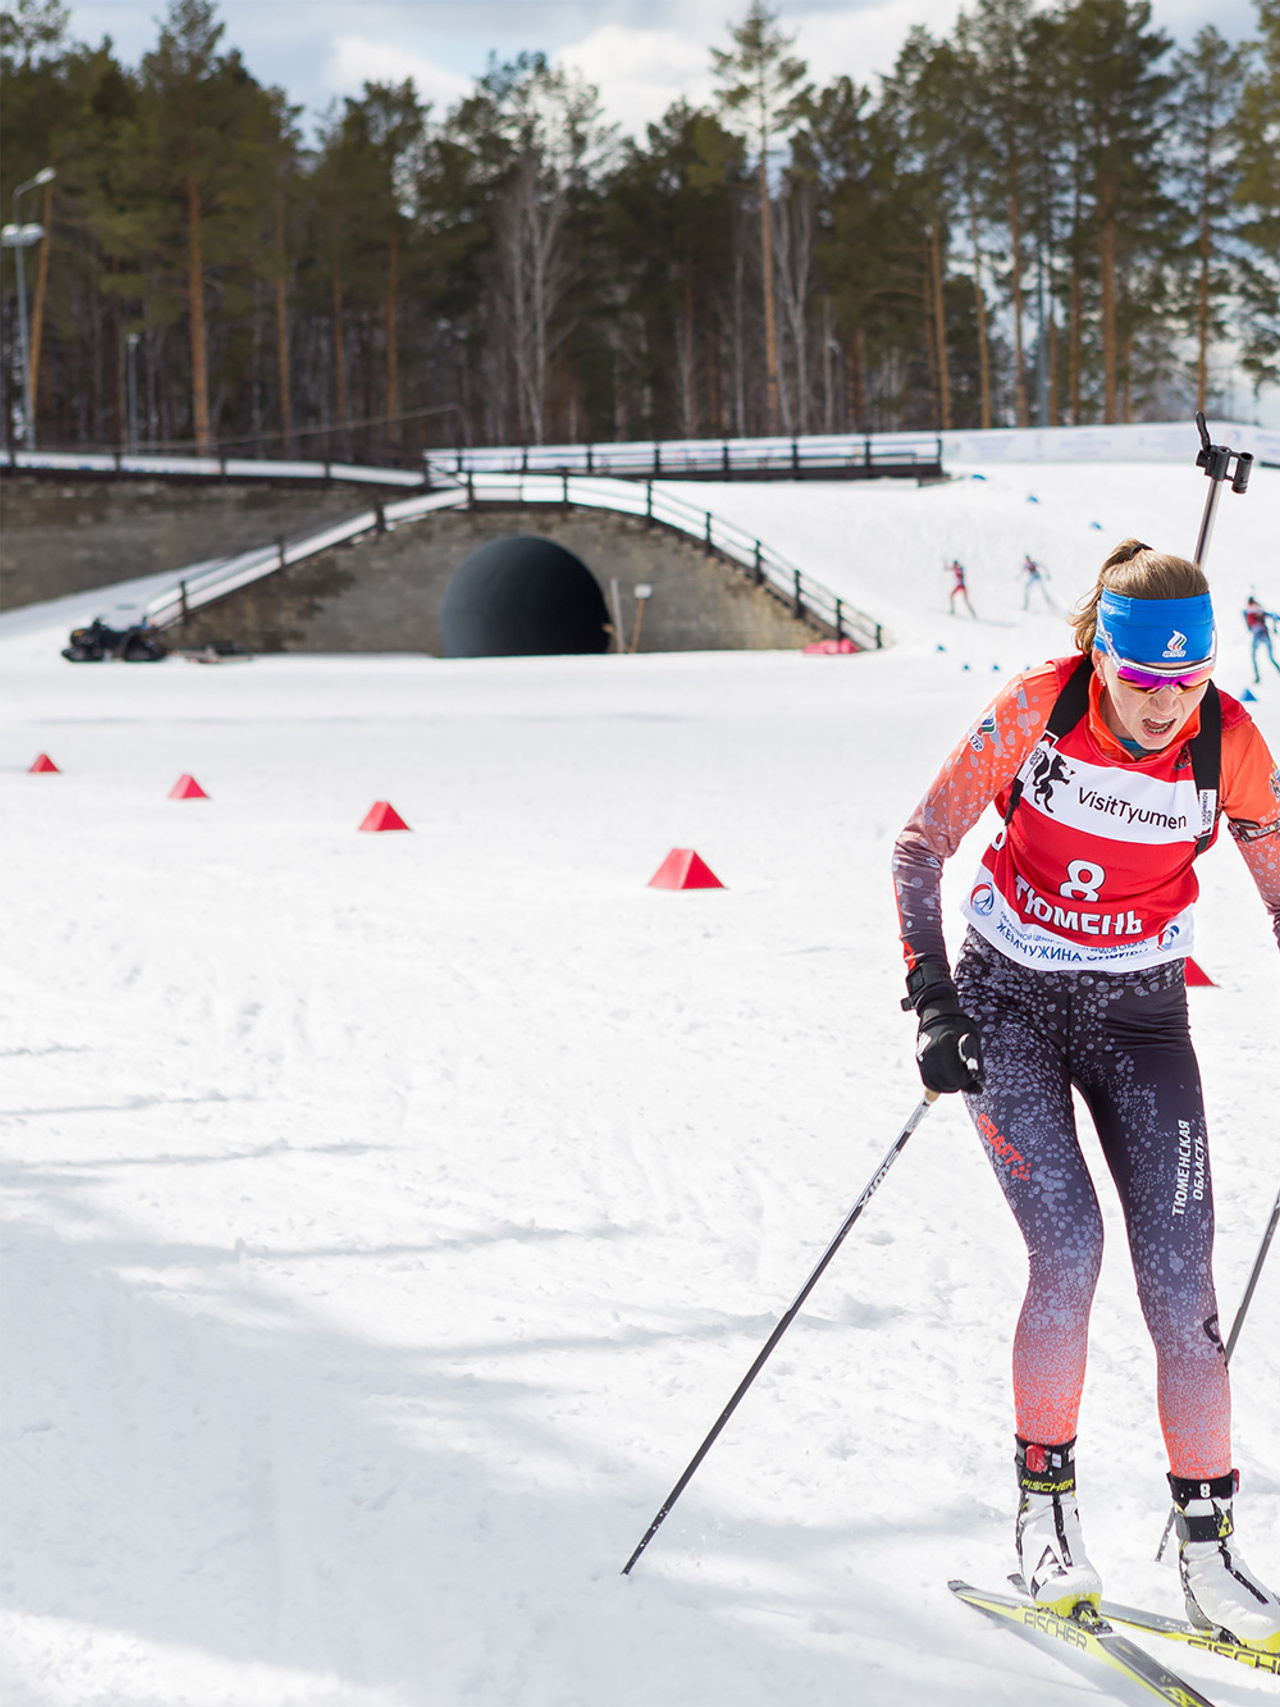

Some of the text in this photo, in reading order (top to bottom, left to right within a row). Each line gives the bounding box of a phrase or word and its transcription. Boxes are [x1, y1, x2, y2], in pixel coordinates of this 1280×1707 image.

[1079, 786, 1187, 829] VisitTyumen
[1059, 859, 1106, 902] 8
[1015, 874, 1143, 936] ТЮМЕНЬ
[977, 1112, 1024, 1165] CRAFT
[1172, 1119, 1191, 1216] ТЮМЕНСКАЯ
[1193, 1135, 1205, 1201] ОБЛАСТЬ
[1021, 1479, 1074, 1492] FISCHER
[1200, 1483, 1211, 1498] 8
[1024, 1611, 1087, 1651] FISCHER
